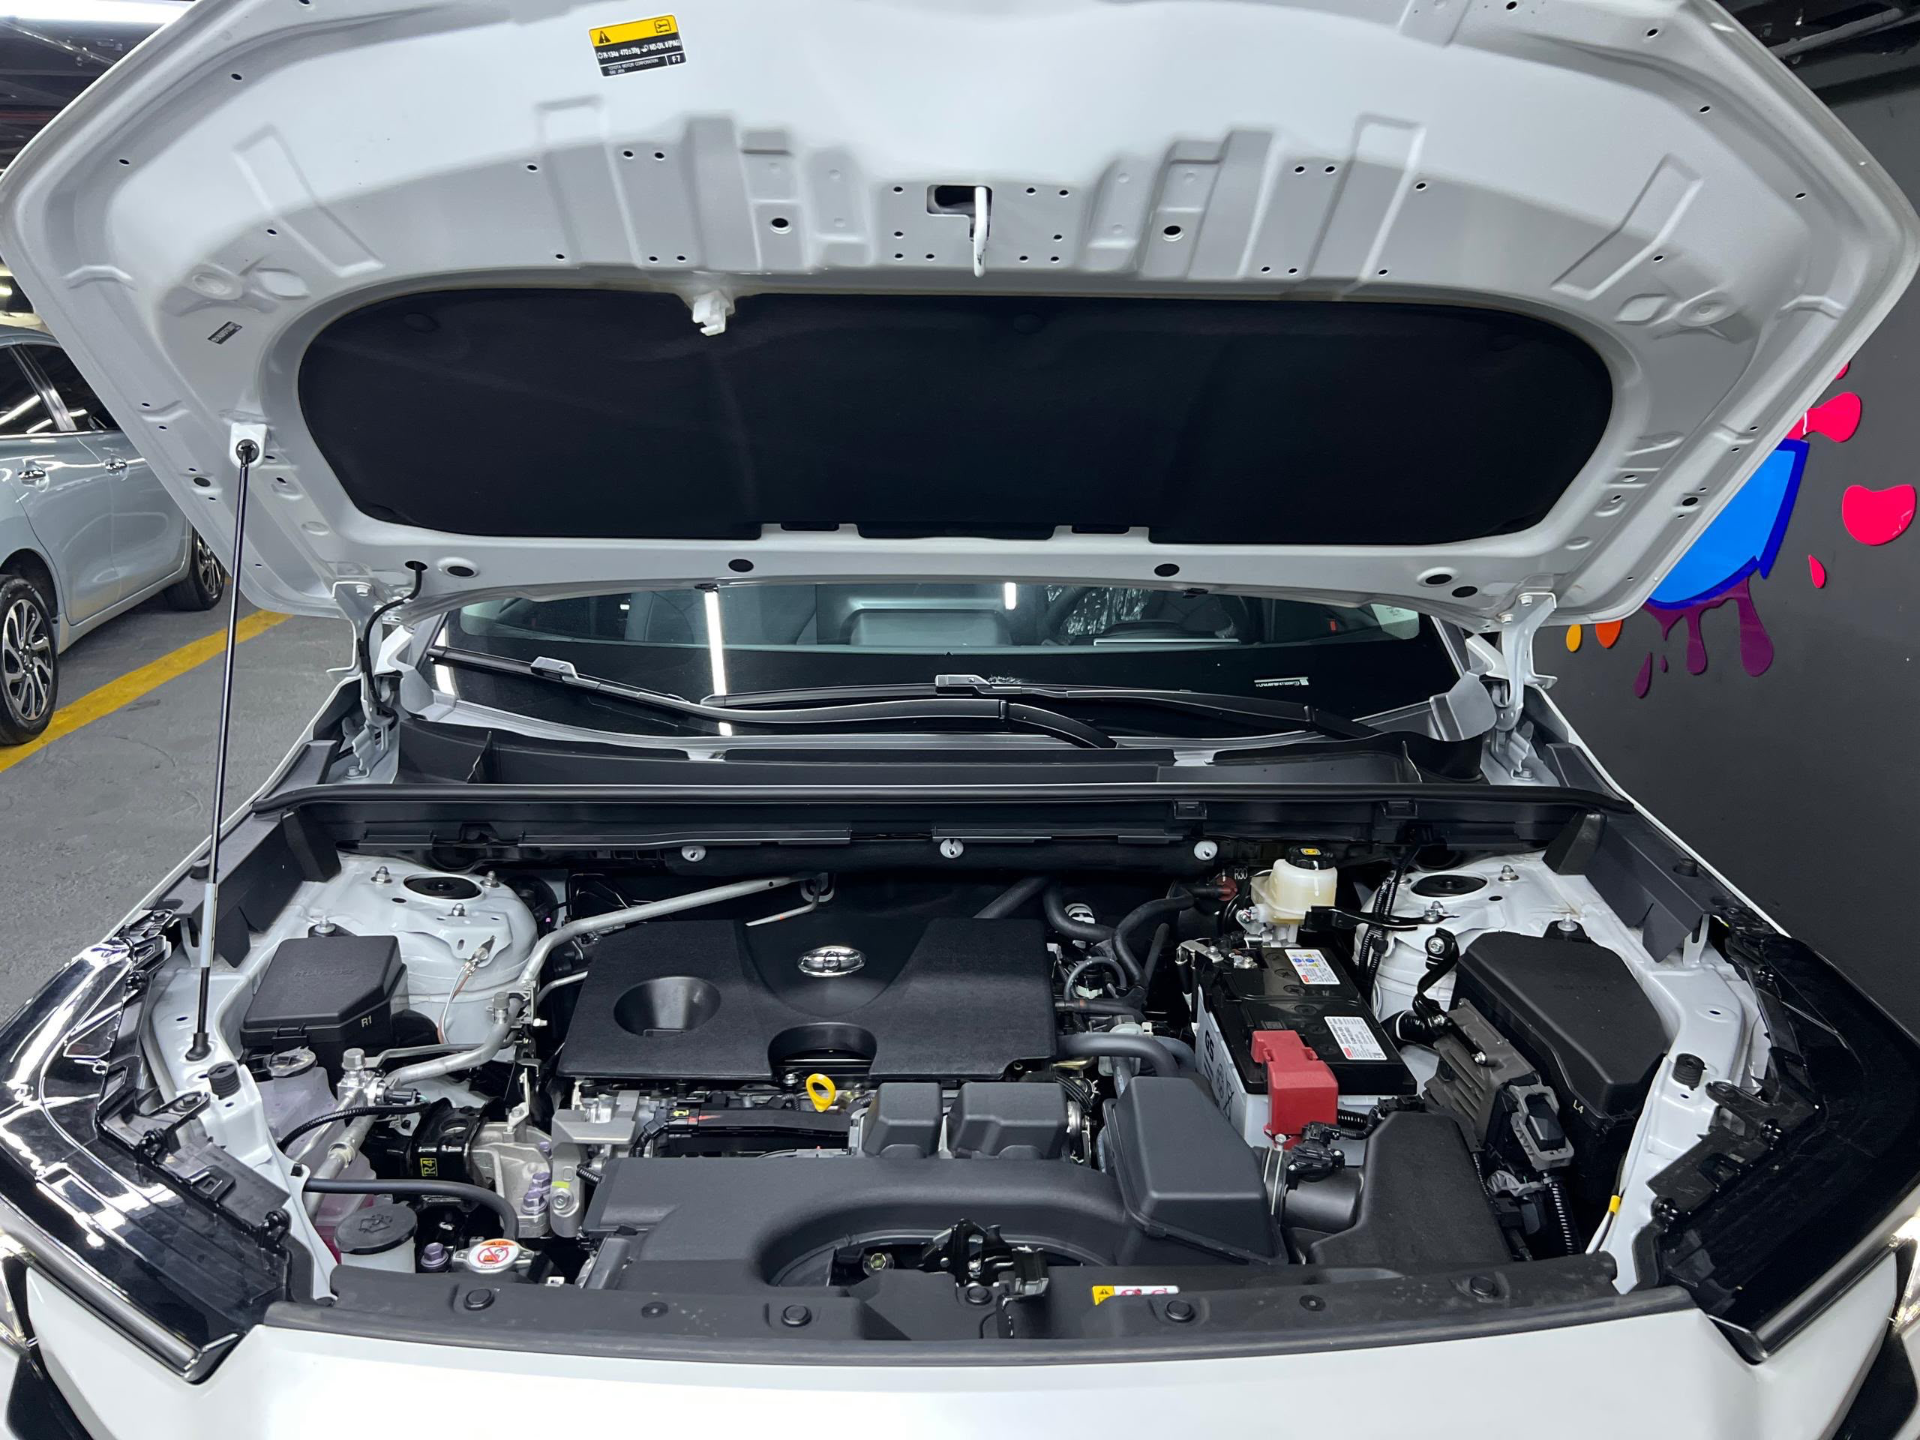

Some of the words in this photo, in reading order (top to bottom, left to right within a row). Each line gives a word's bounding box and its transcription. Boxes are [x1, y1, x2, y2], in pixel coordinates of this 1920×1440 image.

[1234, 867, 1248, 880] R30
[361, 1015, 372, 1028] R1
[1205, 1030, 1214, 1062] GS
[1573, 1099, 1584, 1114] L4
[423, 1160, 436, 1175] R4
